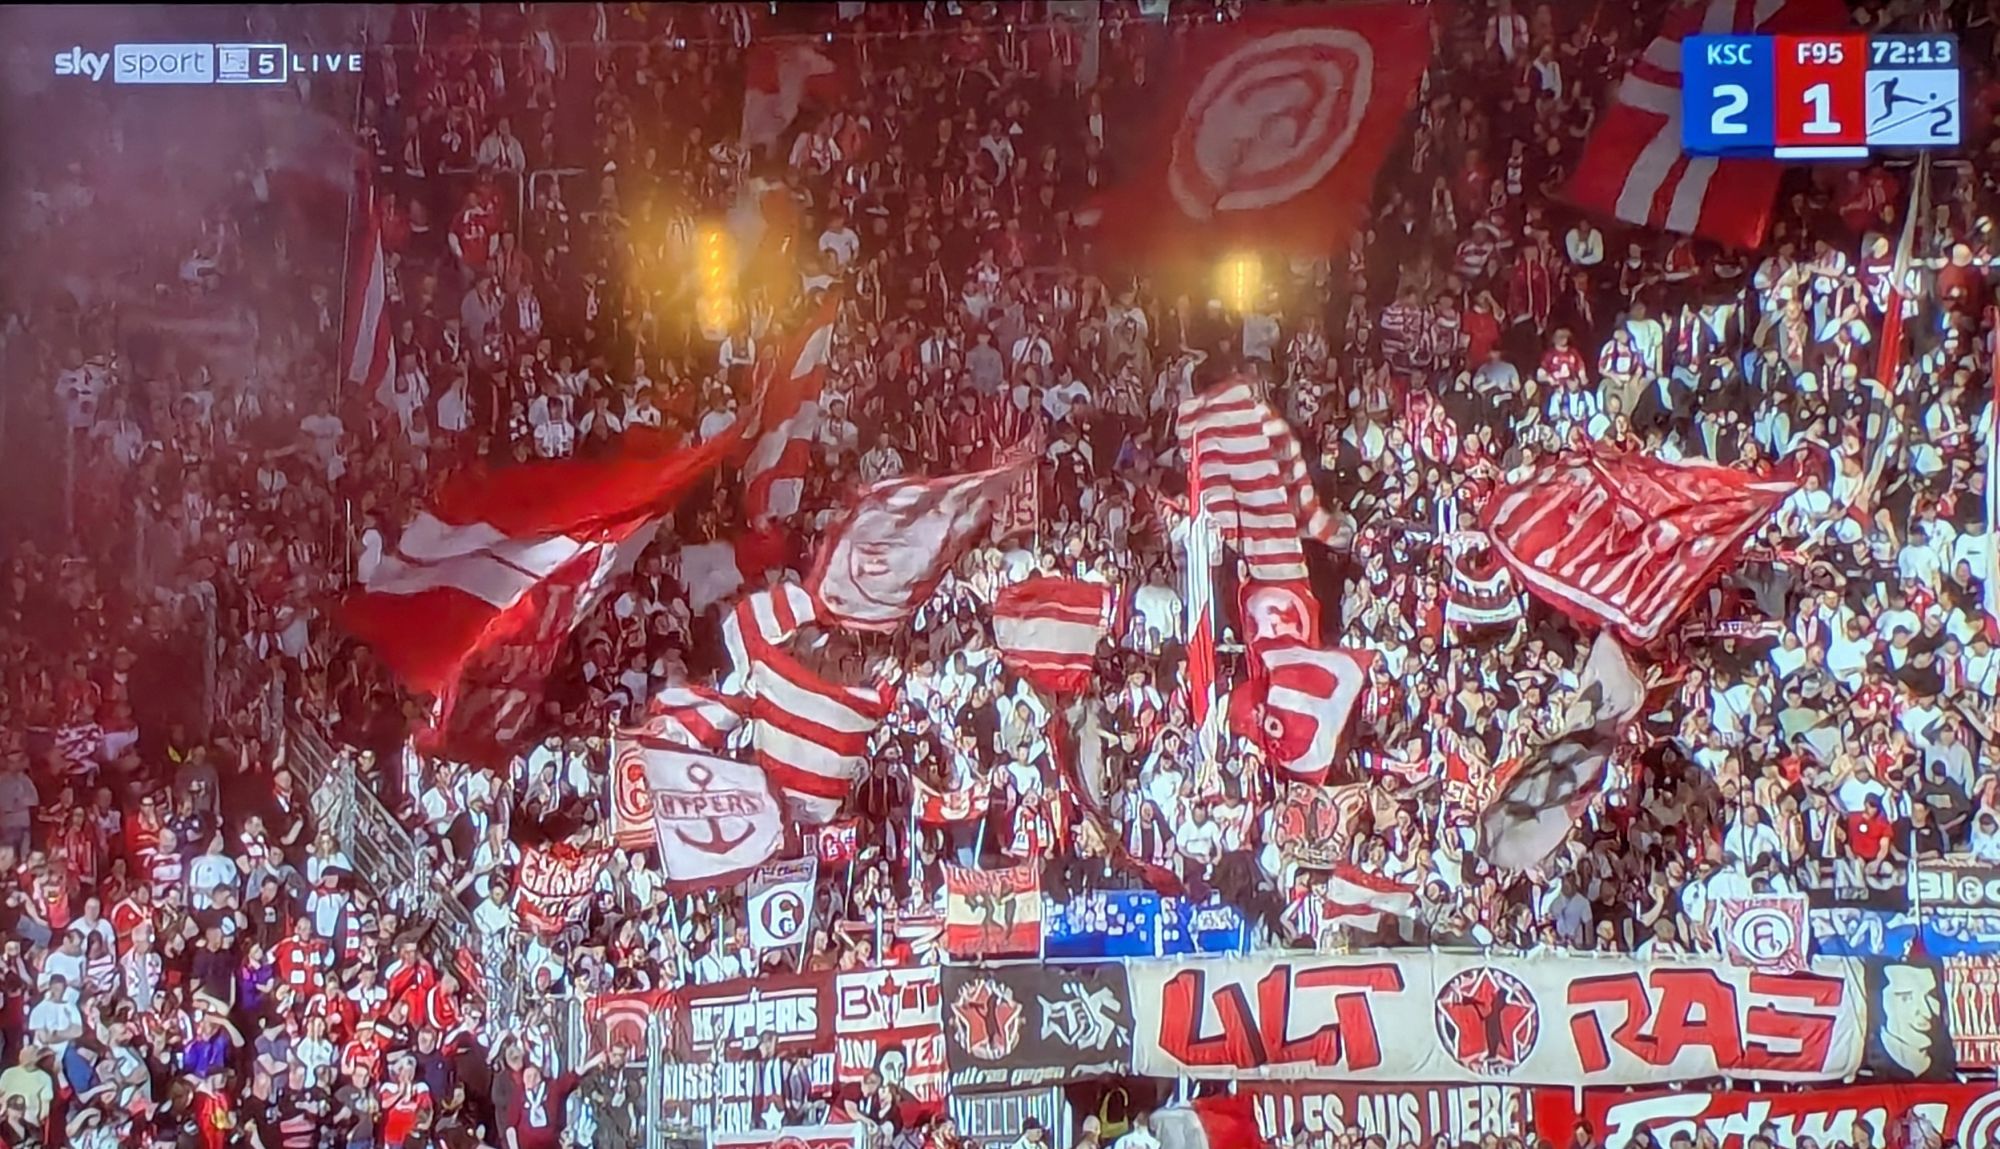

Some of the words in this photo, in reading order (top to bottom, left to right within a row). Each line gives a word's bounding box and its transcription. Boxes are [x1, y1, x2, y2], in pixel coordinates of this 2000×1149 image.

[54, 46, 111, 82] sky
[121, 51, 206, 80] sport
[258, 53, 275, 75] 5
[292, 53, 363, 73] LIVE
[1707, 44, 1752, 66] KSC
[1797, 43, 1843, 65] F95
[1871, 41, 1951, 65] 72:13
[1710, 84, 1749, 135] 2
[1801, 82, 1842, 135] 1
